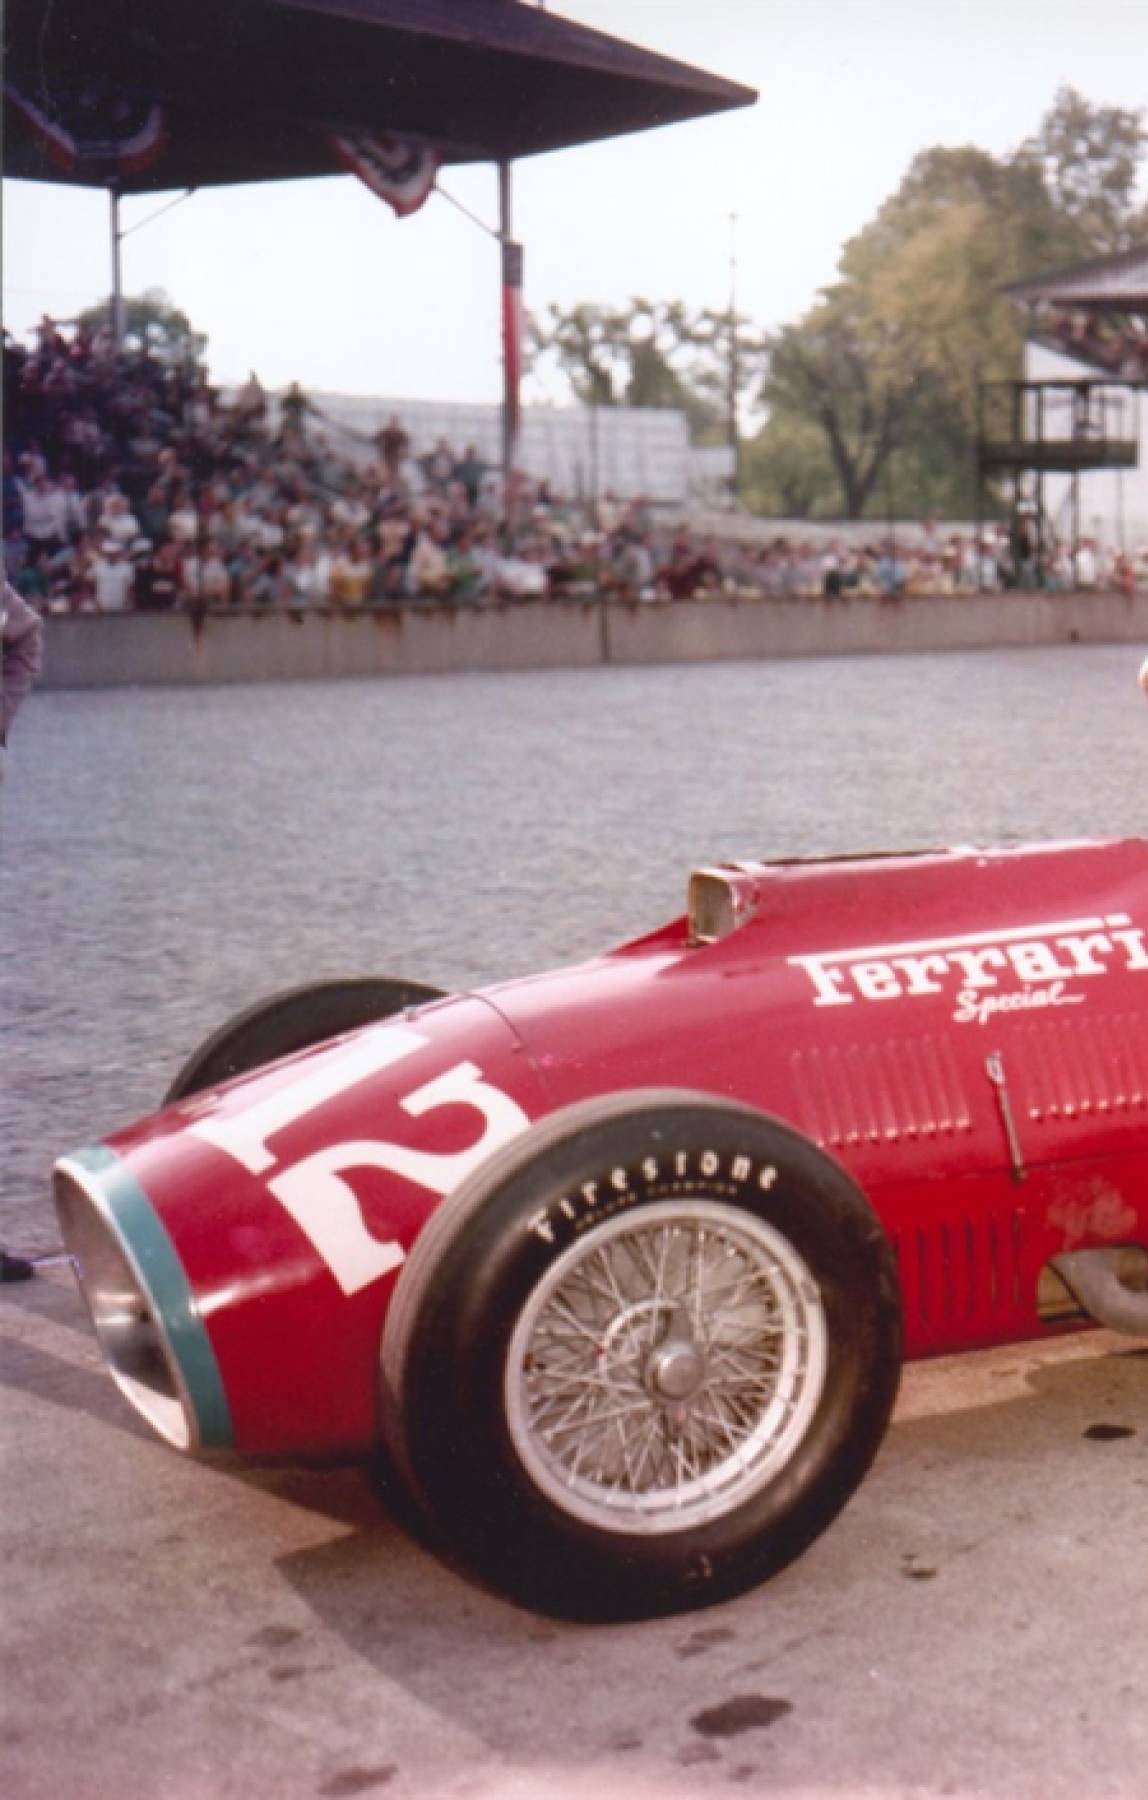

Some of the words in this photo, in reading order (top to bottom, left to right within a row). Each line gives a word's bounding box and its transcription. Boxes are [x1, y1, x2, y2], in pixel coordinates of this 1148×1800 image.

[953, 981, 1086, 1024] Special
[189, 1026, 531, 1296] 12
[529, 1150, 778, 1243] Firestone
